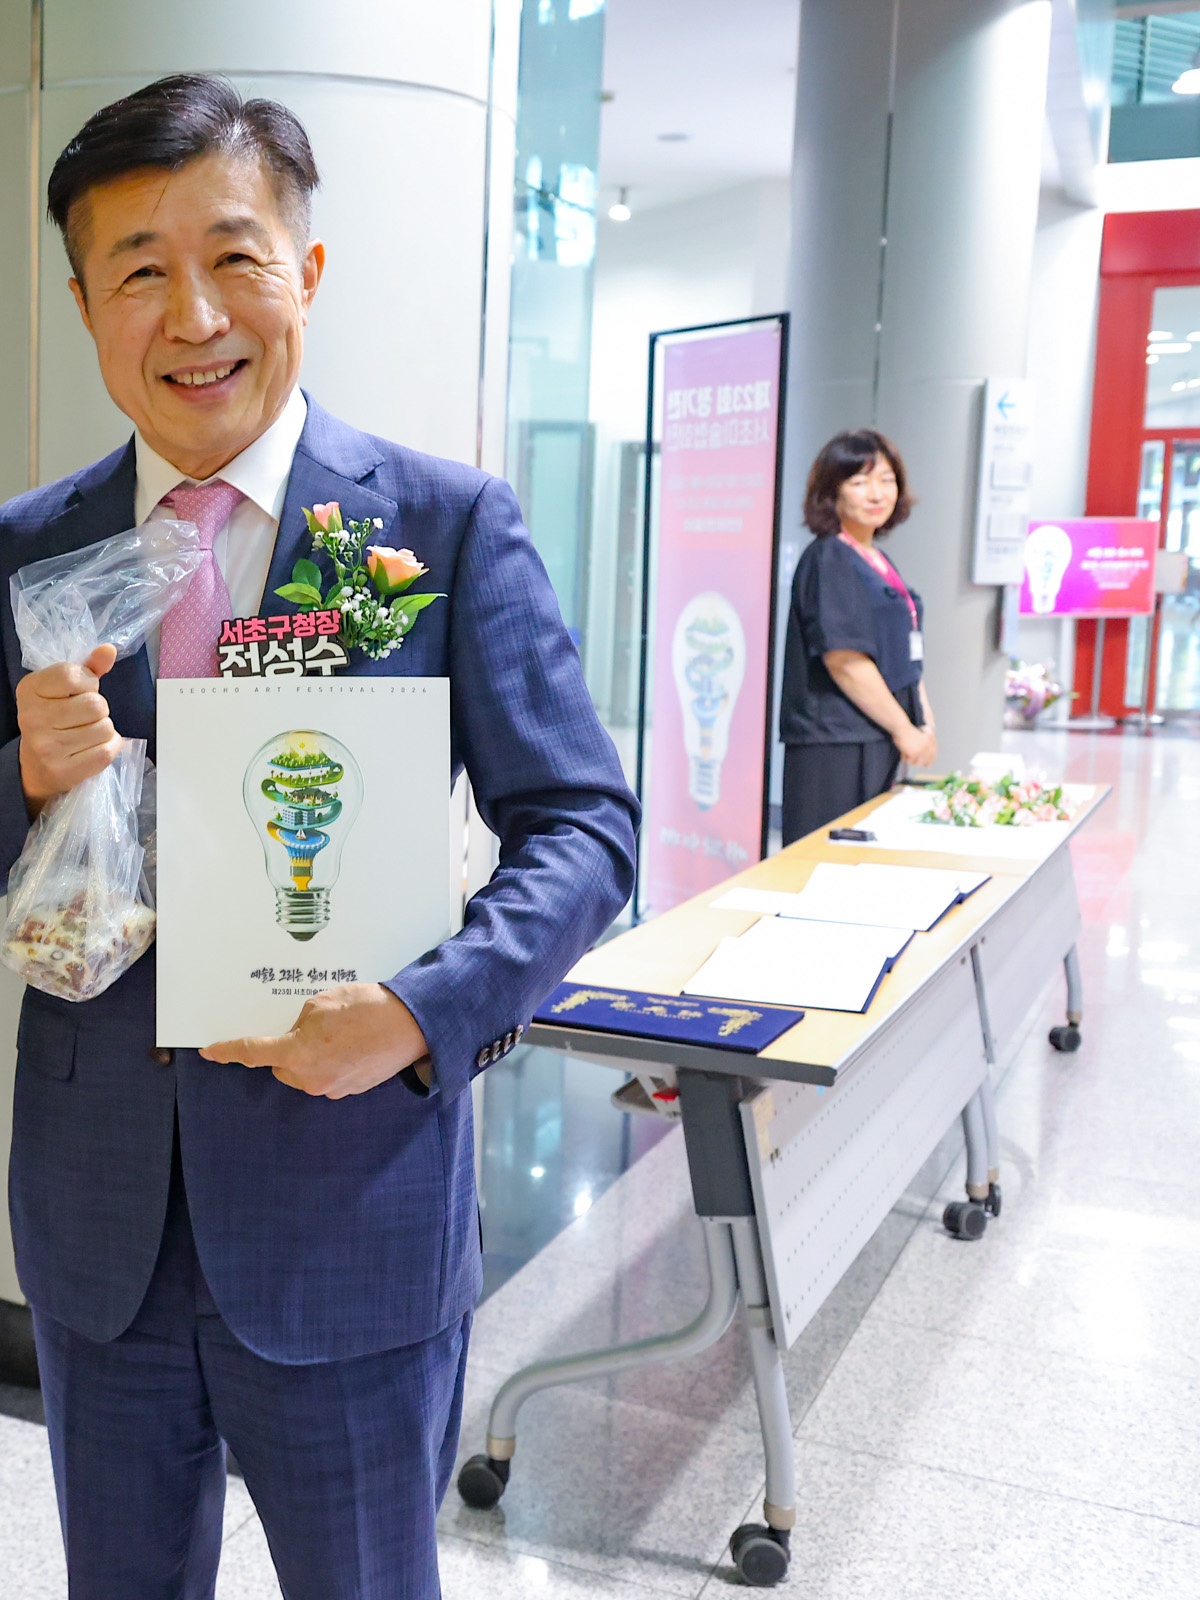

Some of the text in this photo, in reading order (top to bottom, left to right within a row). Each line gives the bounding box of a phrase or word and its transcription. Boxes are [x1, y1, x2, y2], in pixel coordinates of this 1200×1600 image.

[220, 609, 341, 644] 서초구청장
[219, 635, 348, 678] 전성수
[178, 686, 427, 695] SEOCHO ART FESTIVAL 2026
[250, 967, 358, 984] 예술로 그리는 삶의 지형도
[271, 988, 329, 996] 제23회 서초미술
